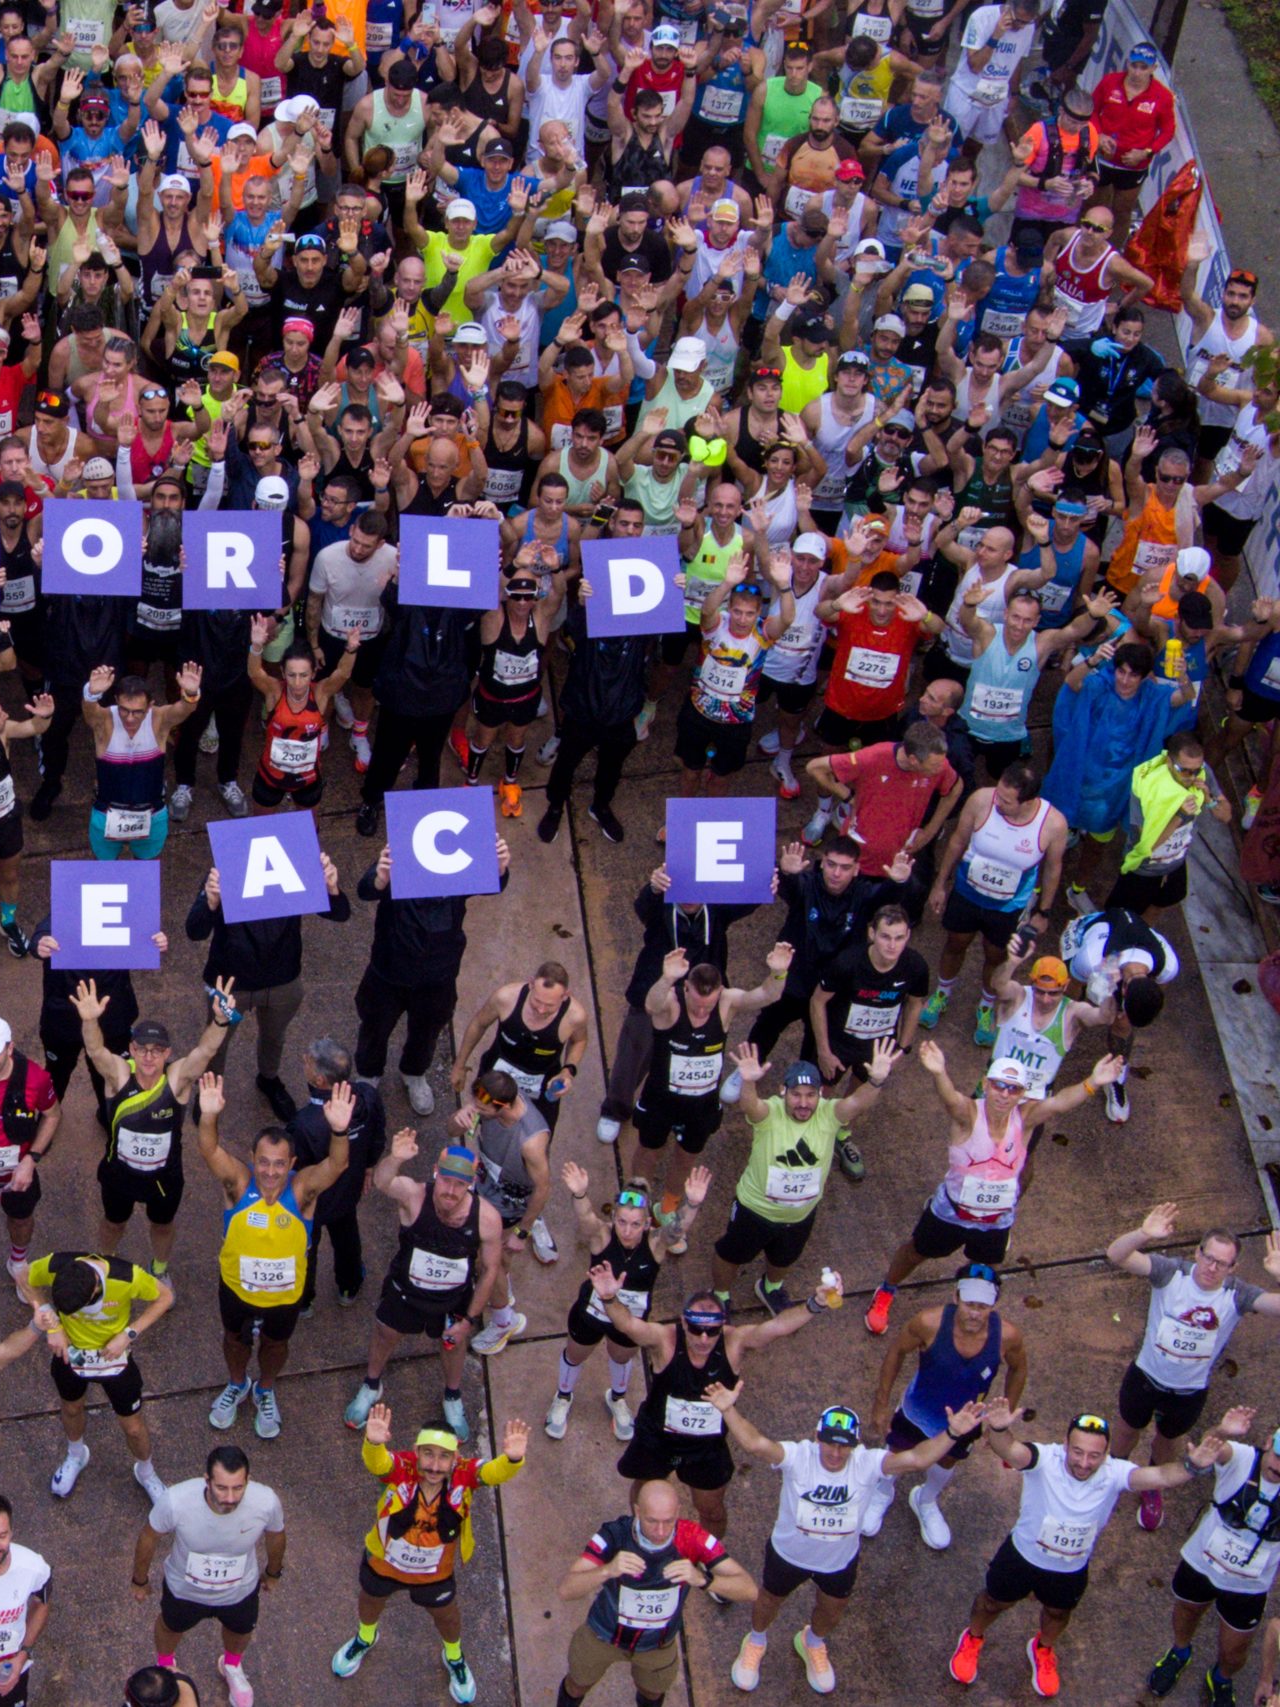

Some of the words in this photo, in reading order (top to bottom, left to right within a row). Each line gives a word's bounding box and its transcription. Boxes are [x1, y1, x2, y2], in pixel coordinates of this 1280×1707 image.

[74, 32, 95, 42] 989
[61, 518, 123, 575] O
[207, 532, 256, 587] R
[427, 534, 470, 587] L
[608, 558, 665, 615] D
[146, 608, 172, 619] 2095
[858, 662, 886, 674] 2275
[707, 673, 733, 688] 2314
[983, 699, 1009, 710] 1931
[117, 823, 143, 833] 1364
[81, 884, 130, 946] E
[242, 836, 305, 898] A
[412, 811, 473, 874] C
[696, 821, 744, 882] E
[981, 874, 1003, 886] 644
[678, 1069, 714, 1080] 24543
[132, 1146, 155, 1157] 363
[783, 1184, 805, 1194] 547
[976, 1194, 999, 1204] 638
[252, 1271, 284, 1281] 1326
[426, 1267, 450, 1278] 357
[1173, 1339, 1197, 1352] 629
[681, 1417, 705, 1429] 672
[812, 1484, 848, 1502] RUN
[811, 1517, 843, 1528] 1191
[1054, 1535, 1085, 1548] 1912
[401, 1553, 425, 1564] 669
[204, 1568, 228, 1577] 311
[637, 1604, 663, 1615] 736
